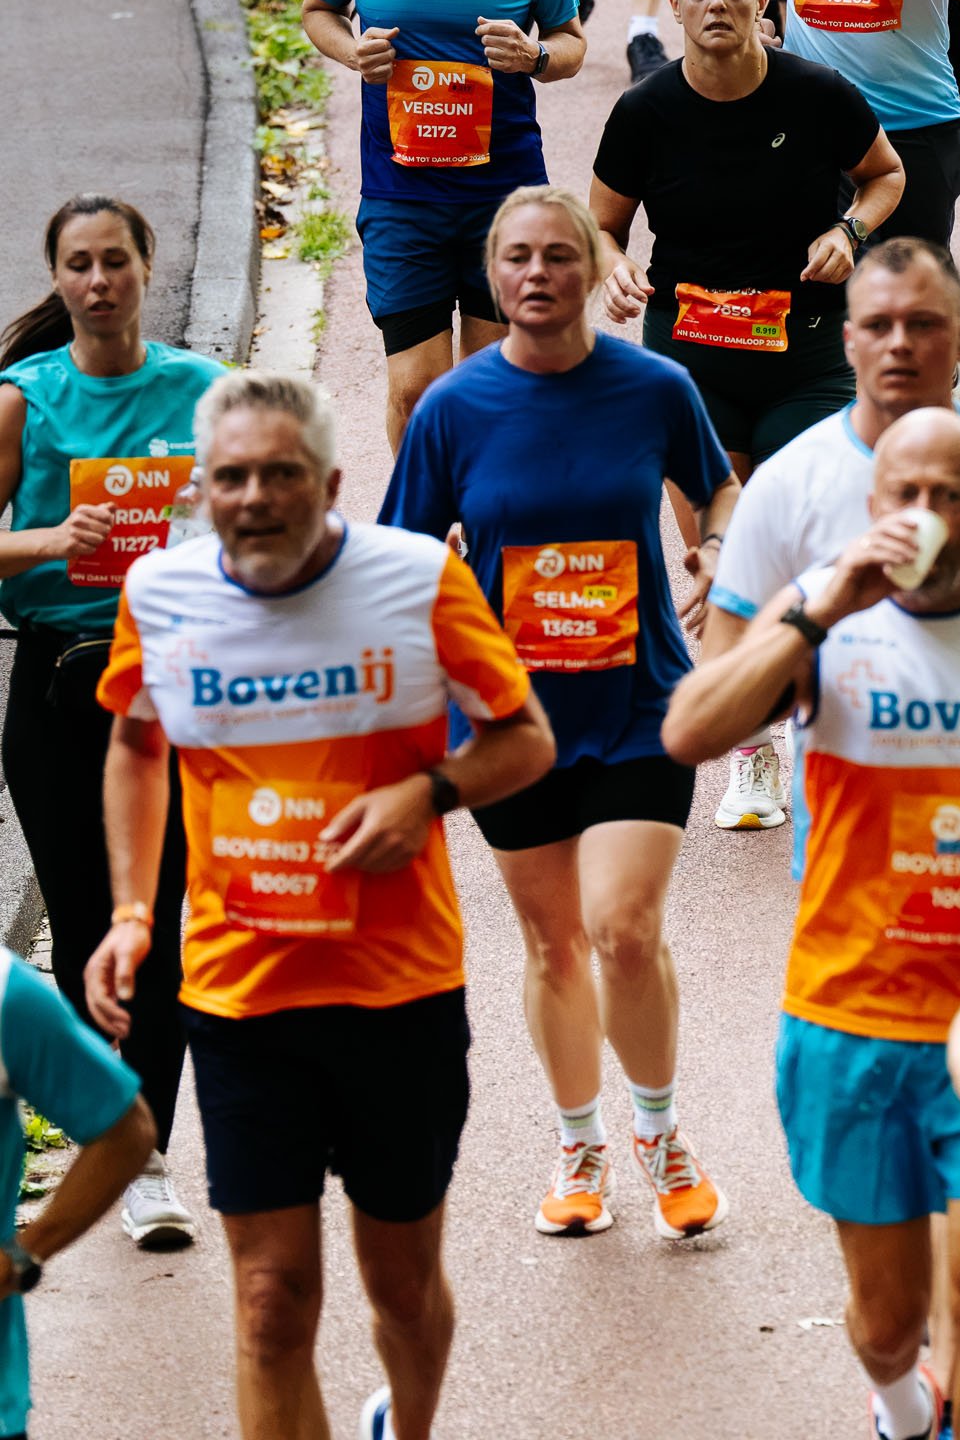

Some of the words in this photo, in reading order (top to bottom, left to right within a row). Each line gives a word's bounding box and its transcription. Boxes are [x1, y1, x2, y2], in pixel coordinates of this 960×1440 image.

[811, 18, 828, 27] DAM
[828, 20, 843, 28] TOT
[844, 21, 881, 29] DAMLOOP
[881, 18, 898, 28] 2026
[438, 72, 466, 86] NN
[402, 100, 473, 116] VERSUNI
[416, 124, 457, 138] 12172
[689, 331, 707, 340] DAM
[708, 333, 723, 342] TOT
[724, 336, 765, 346] DAMLOOP
[766, 339, 785, 347] 2026
[755, 327, 777, 335] 6.919
[137, 469, 170, 488] NN
[111, 535, 160, 552] 11272
[569, 554, 605, 572] NN
[533, 590, 606, 609] SELMA
[541, 619, 598, 637] 13625
[190, 647, 395, 706] Bovenij
[284, 797, 325, 820] NN
